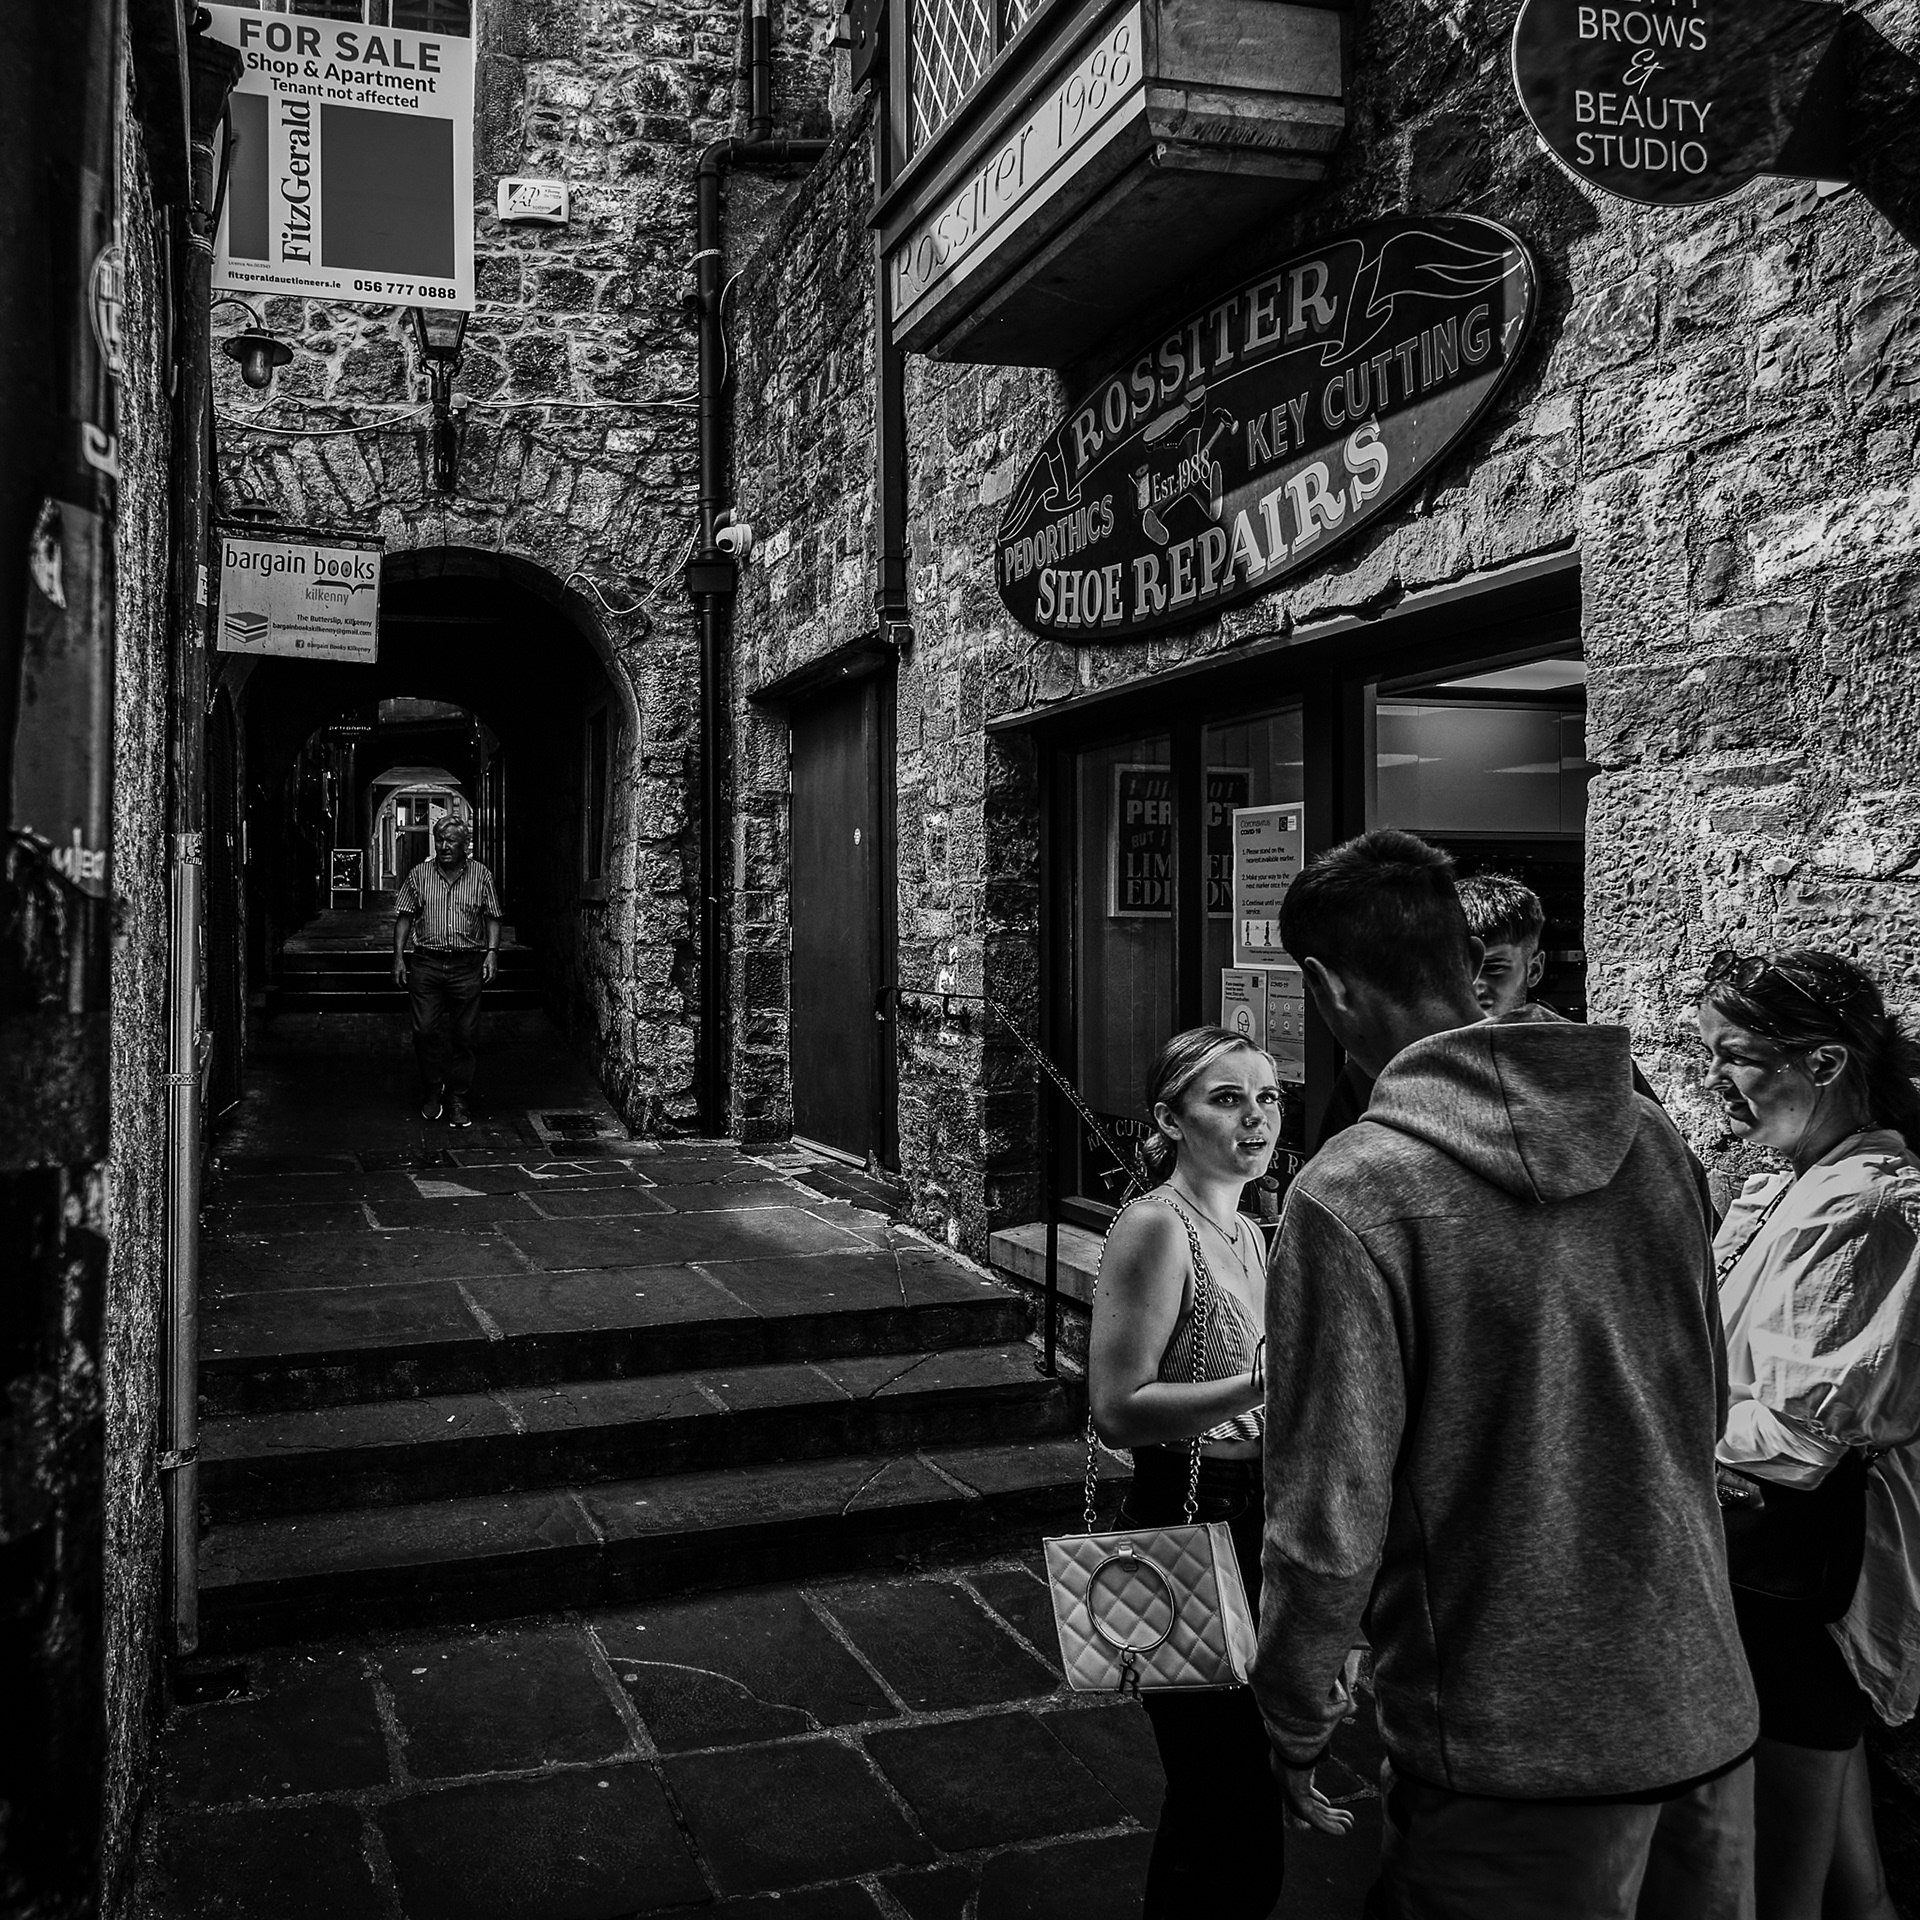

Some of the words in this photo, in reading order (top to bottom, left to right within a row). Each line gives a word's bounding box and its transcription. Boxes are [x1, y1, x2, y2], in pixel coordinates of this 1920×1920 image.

[239, 17, 322, 58] FOR
[335, 31, 442, 74] SALE
[1578, 6, 1707, 51] BROWS
[246, 52, 300, 79] Shop
[303, 60, 320, 79] &
[324, 62, 437, 94] Apartment
[270, 76, 324, 97] Tenant
[327, 87, 354, 101] not
[356, 89, 420, 109] affected
[1575, 90, 1713, 133] BEAUTY
[896, 125, 1034, 312] Rossiter
[1057, 25, 1132, 149] 1988
[1575, 132, 1708, 175] STUDIO
[280, 98, 312, 267] FitzGerald
[227, 270, 342, 290] fitzgeraldauctioneers.ie
[353, 279, 383, 294] 056
[386, 281, 415, 296] 777
[418, 285, 457, 300] 0888
[1071, 260, 1338, 470] ROSSITER
[1247, 391, 1310, 468] KEY
[1322, 303, 1493, 428] CUTTING
[1004, 494, 1115, 585] PEDORTHICS
[1036, 562, 1123, 628] SHOE
[1132, 412, 1390, 622] REPAIRS
[225, 543, 306, 577] bargain
[314, 551, 375, 580] books
[305, 588, 349, 605] kilkenny
[297, 614, 309, 622] The
[310, 615, 343, 626] Butterslip,
[344, 618, 373, 628] Kilkenny
[1131, 830, 1155, 849] BUT
